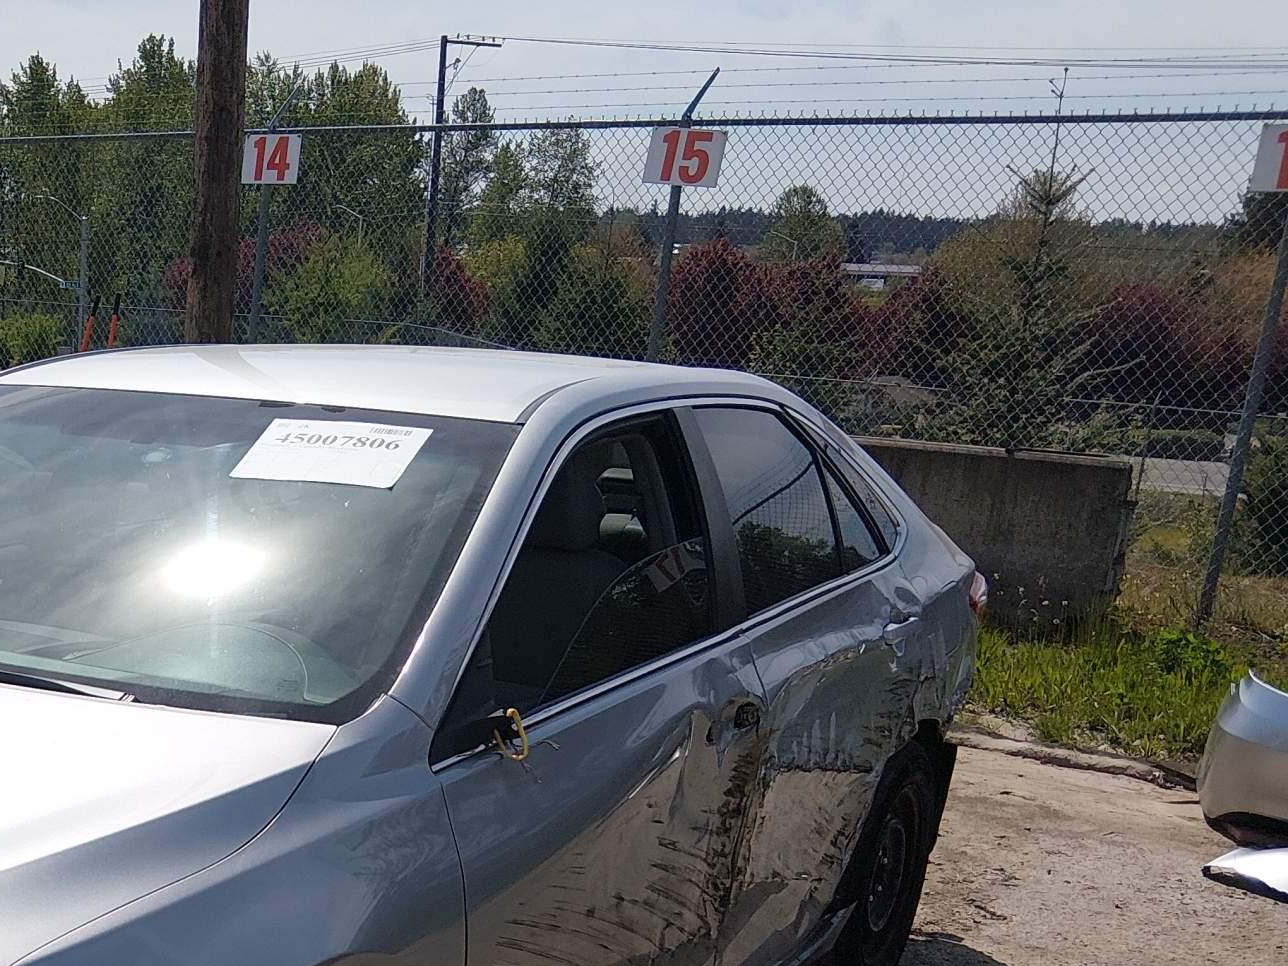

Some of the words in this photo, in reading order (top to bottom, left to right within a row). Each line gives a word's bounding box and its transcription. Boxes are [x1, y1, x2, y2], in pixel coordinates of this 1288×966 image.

[253, 136, 290, 181] 14
[660, 130, 713, 183] 15
[274, 432, 403, 451] 45007806
